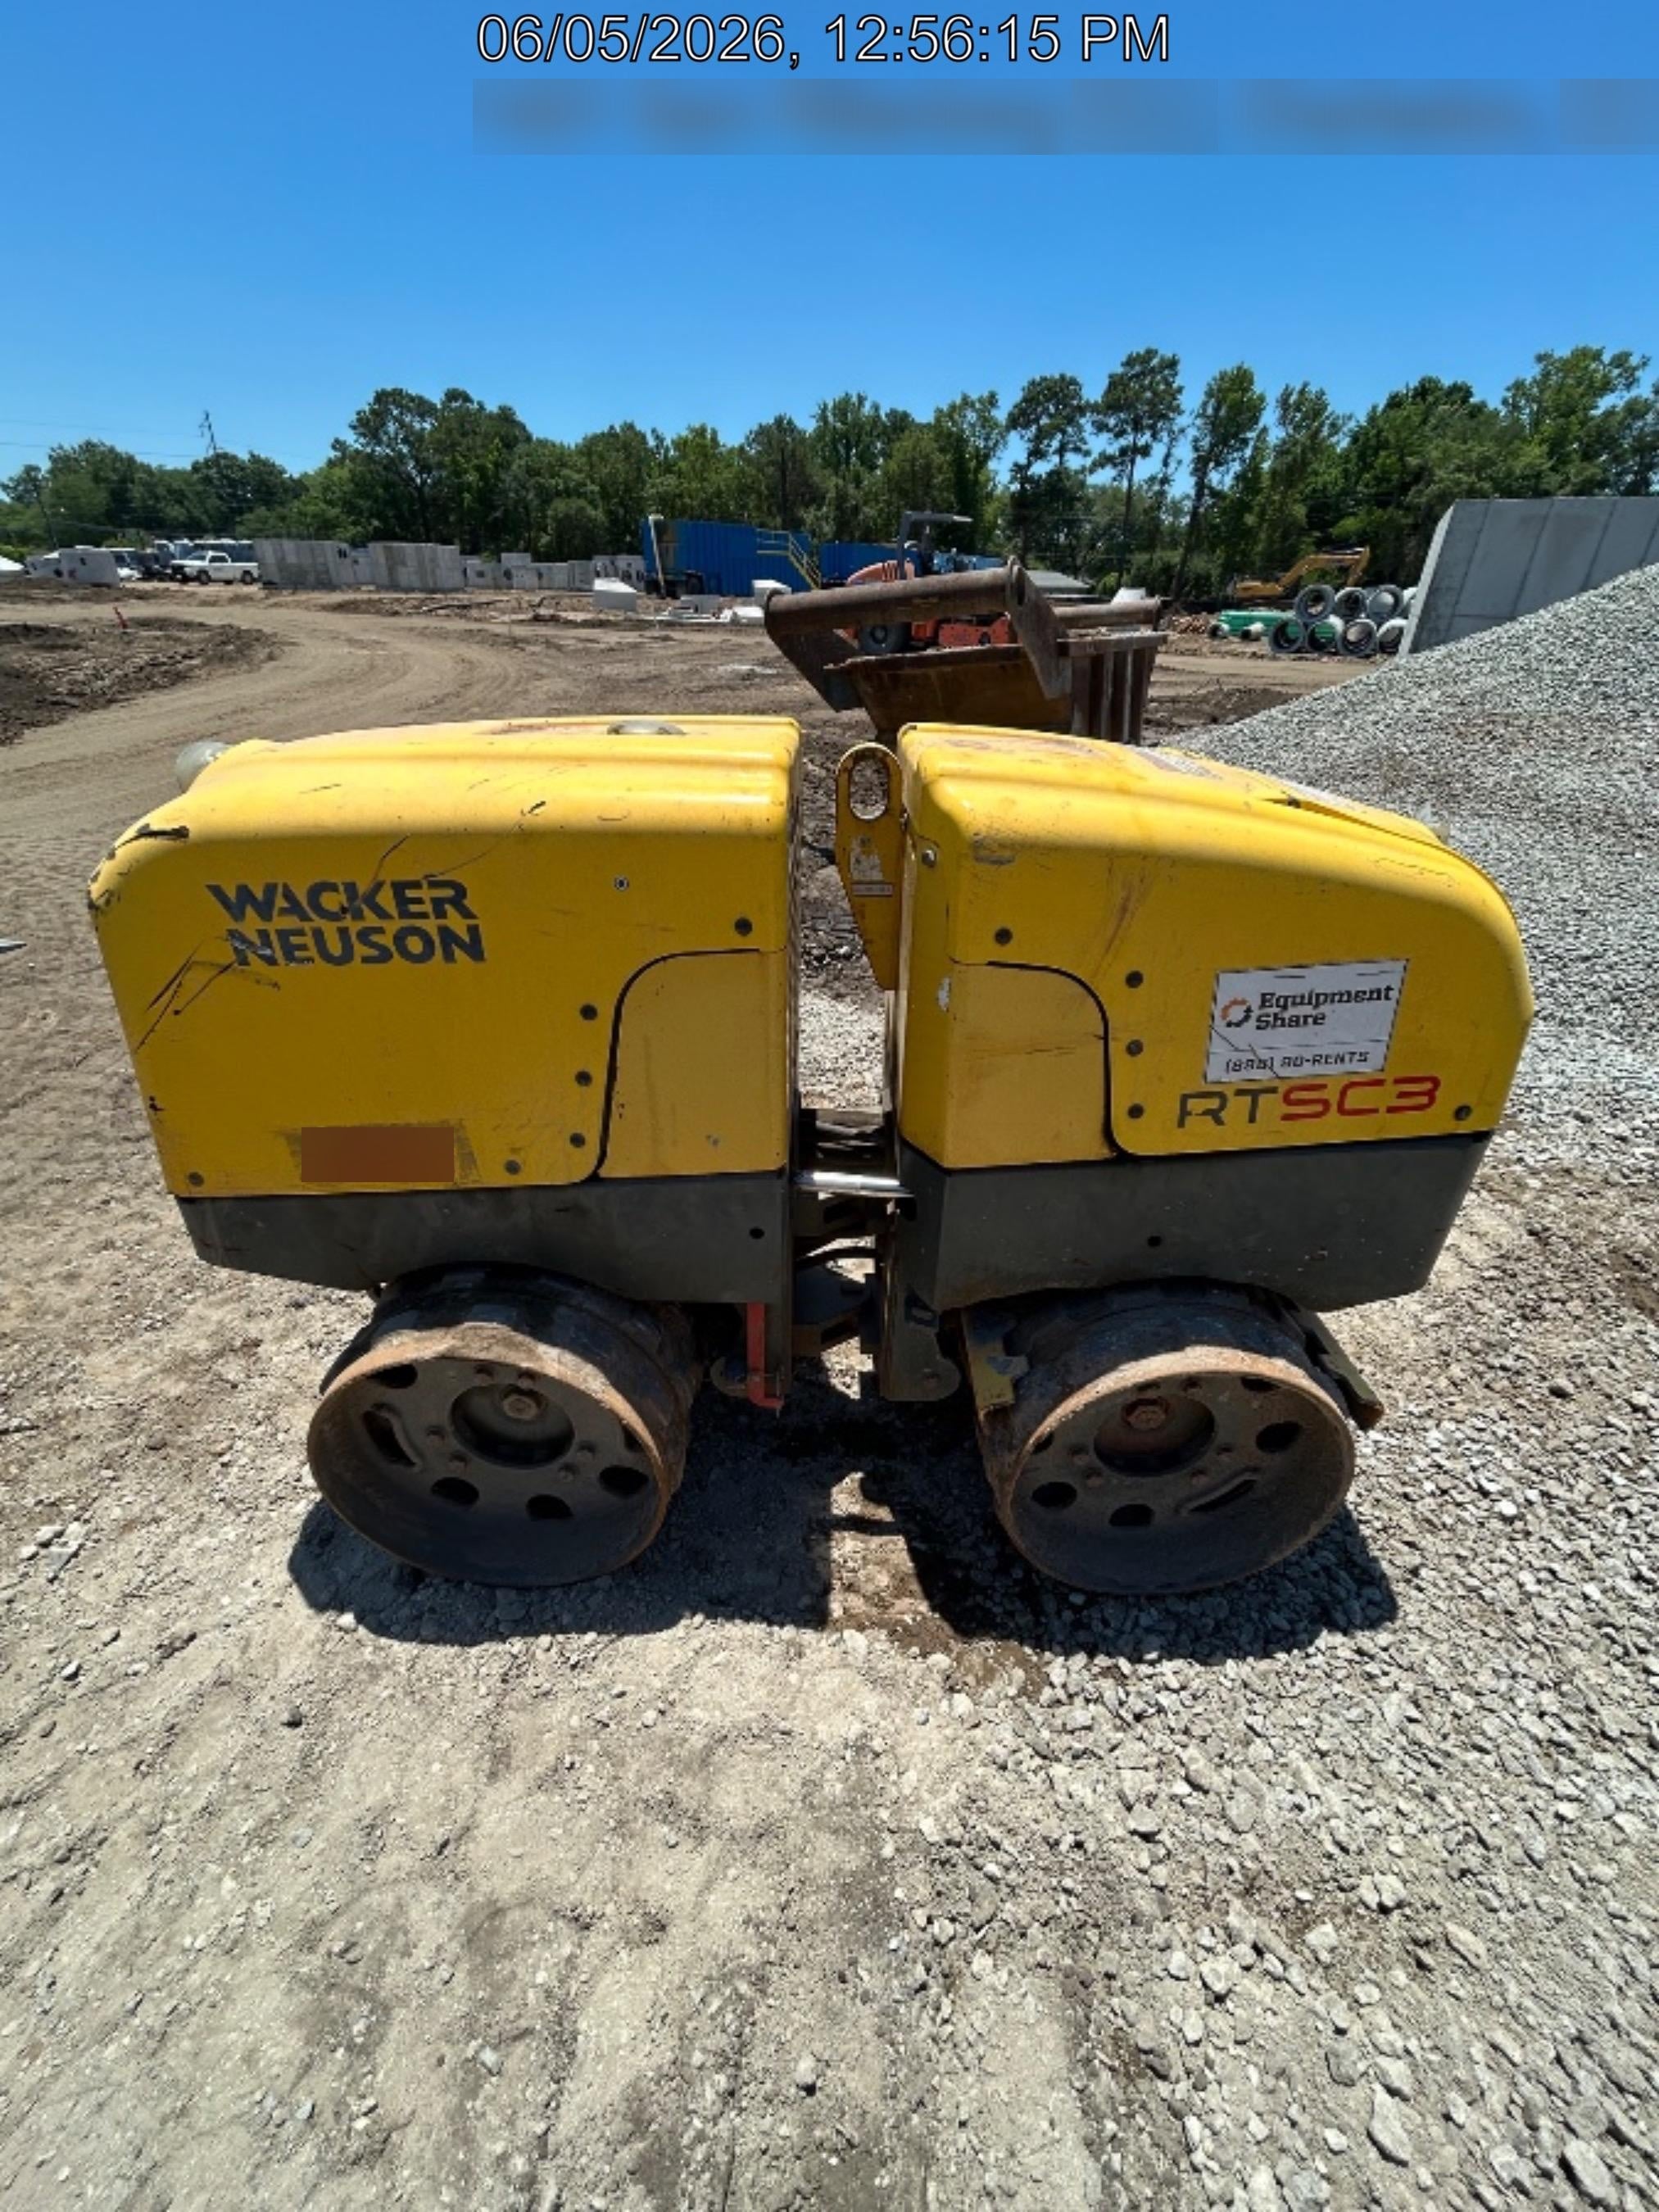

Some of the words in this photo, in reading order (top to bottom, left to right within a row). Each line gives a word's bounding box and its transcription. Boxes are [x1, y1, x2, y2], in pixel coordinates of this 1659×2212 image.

[206, 879, 479, 923] WACKER
[225, 923, 487, 967] NEUSON
[1258, 985, 1394, 1010] Equipment
[1255, 1013, 1326, 1030] Share
[1176, 1076, 1441, 1129] RTSC3
